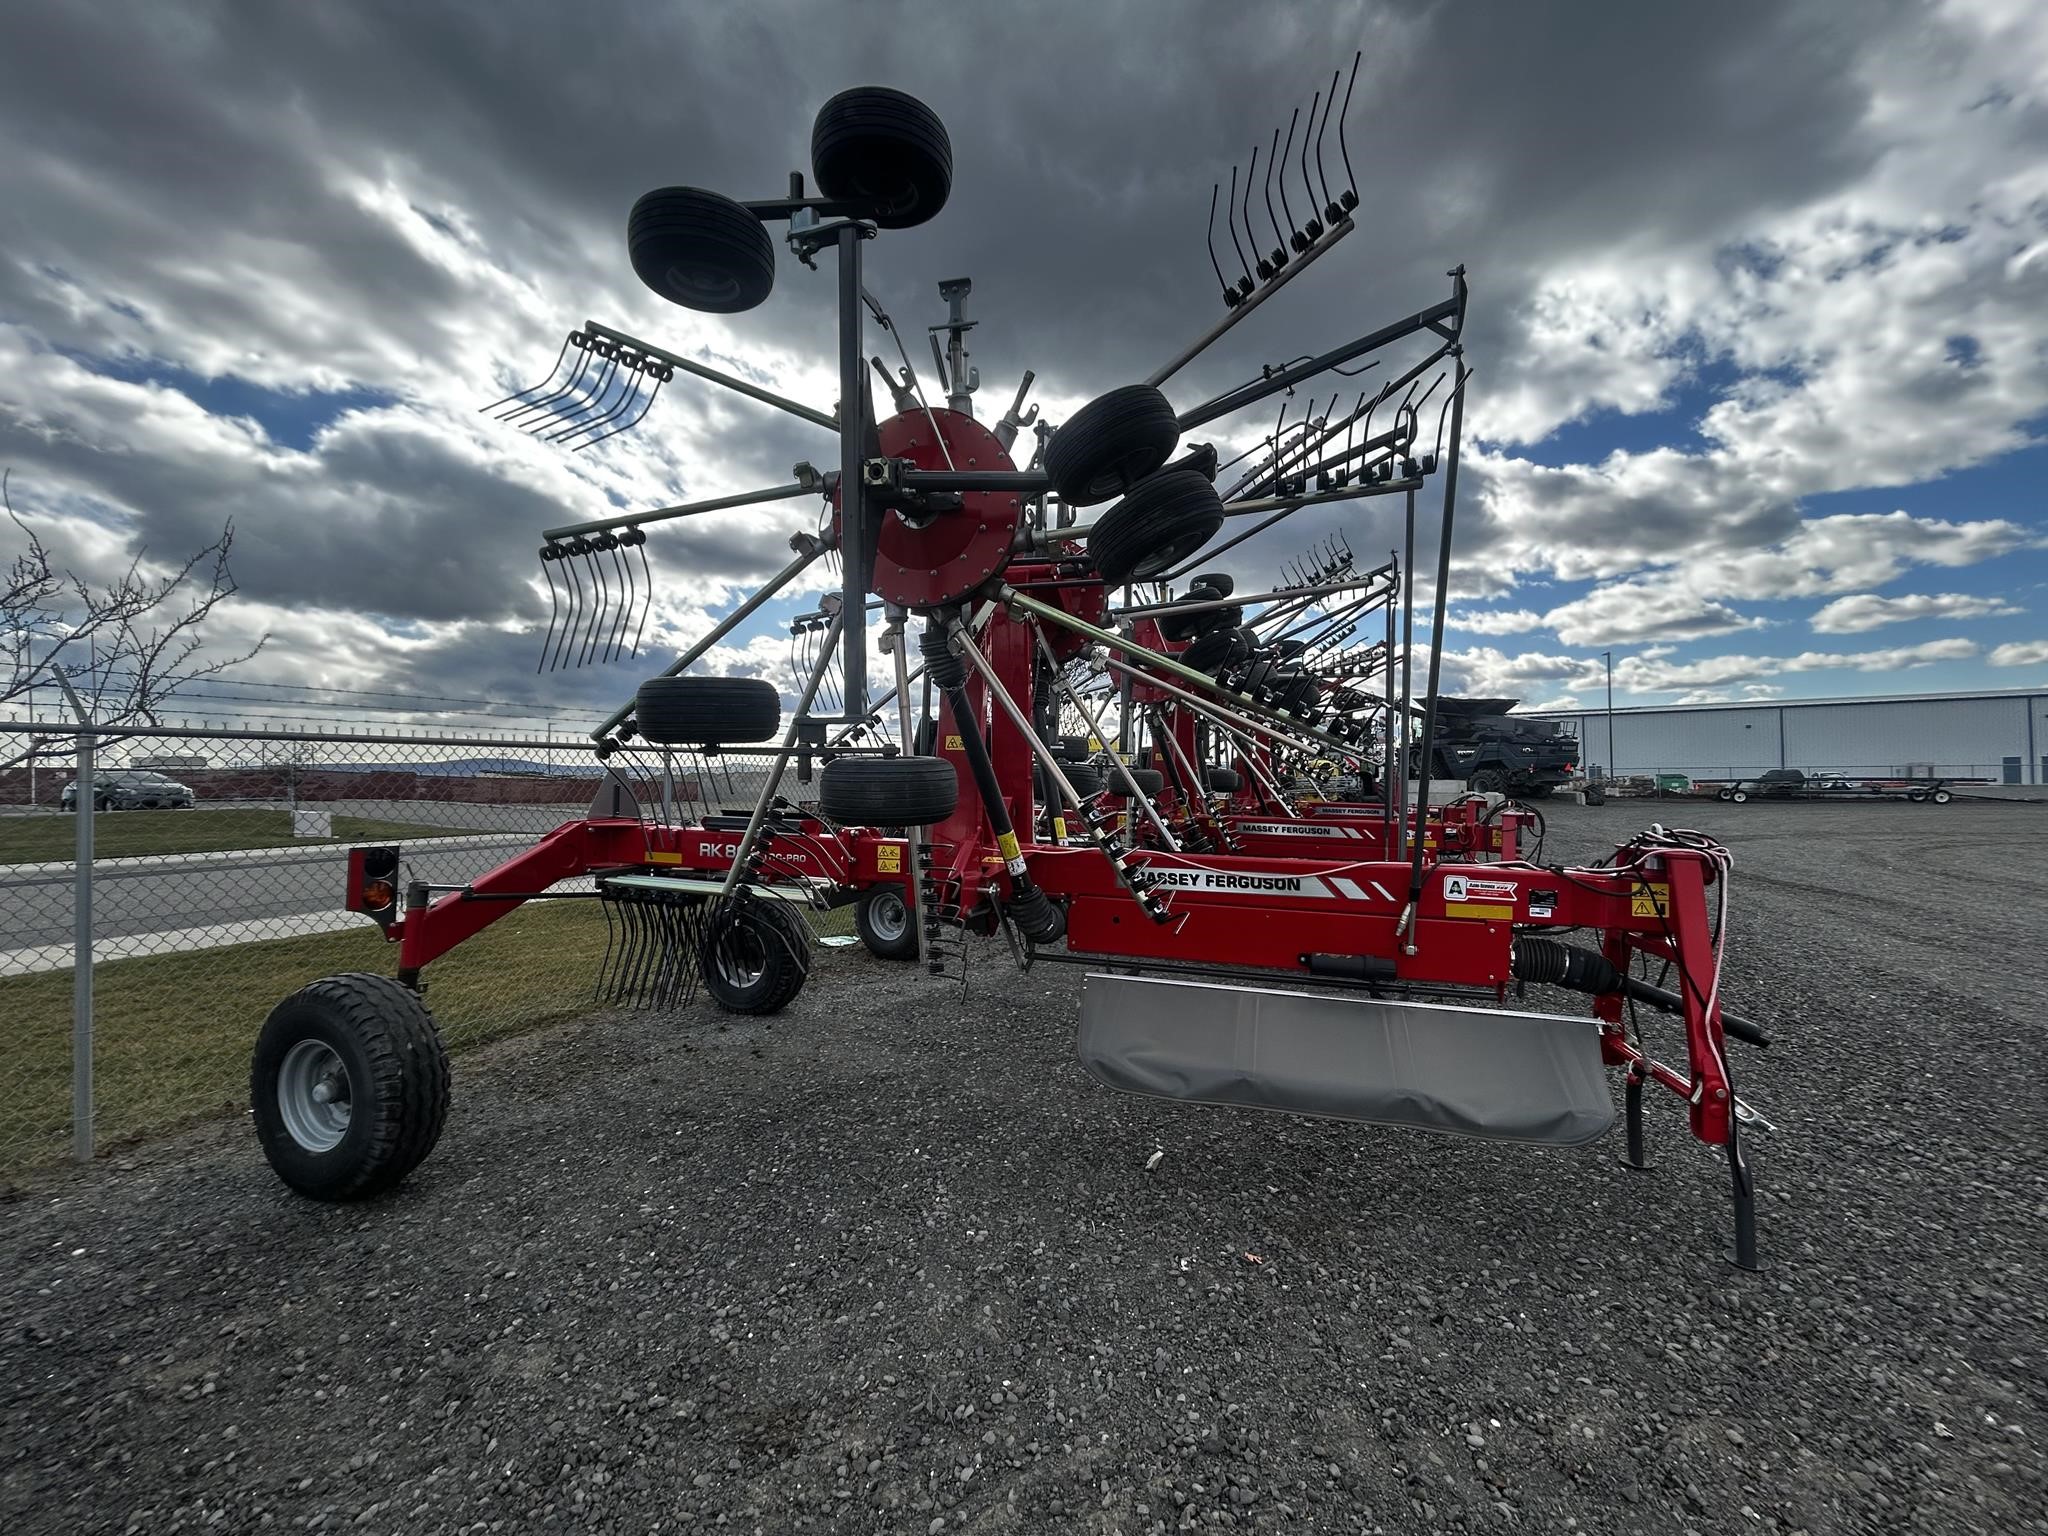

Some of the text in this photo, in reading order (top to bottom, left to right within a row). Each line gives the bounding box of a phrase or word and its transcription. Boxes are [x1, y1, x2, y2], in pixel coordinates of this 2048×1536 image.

[1243, 825, 1331, 835] MASSEY FERGUSON
[700, 843, 723, 857] RK
[1206, 874, 1301, 891] FERGUSON
